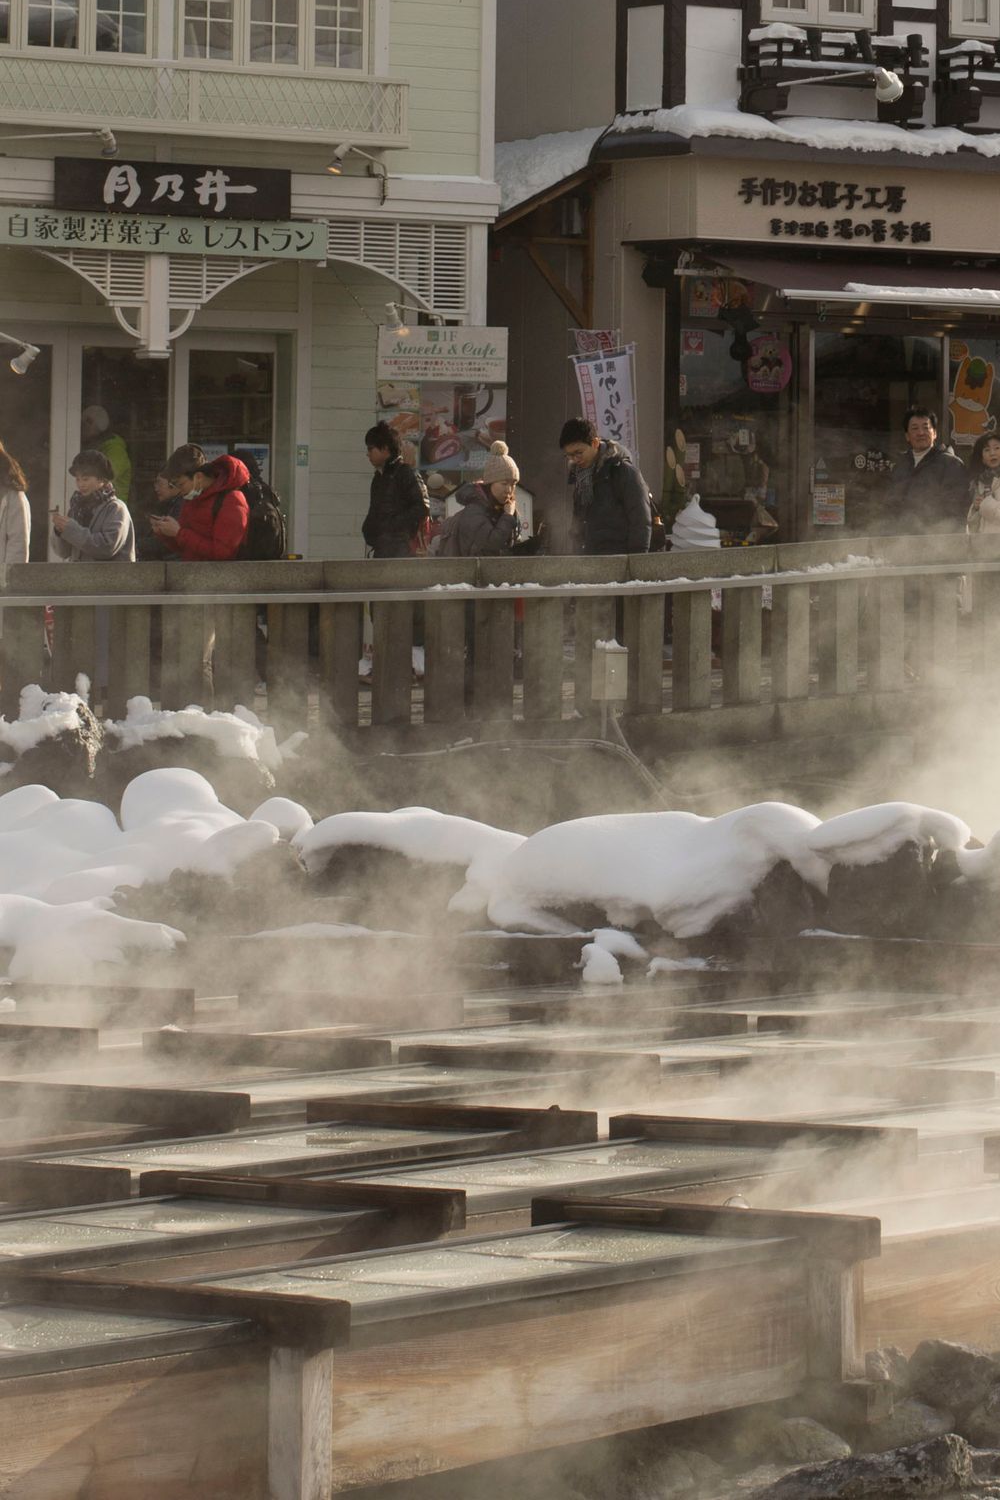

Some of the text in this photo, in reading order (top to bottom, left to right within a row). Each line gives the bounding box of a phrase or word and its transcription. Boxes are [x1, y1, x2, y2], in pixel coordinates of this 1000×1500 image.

[103, 165, 258, 212] 月乃井
[738, 177, 907, 213] 手作りお菓子工房
[8, 213, 170, 245] 自家製洋菓子
[203, 225, 315, 252] レストラン
[392, 340, 442, 355] Sweets
[461, 341, 497, 358] Cafe
